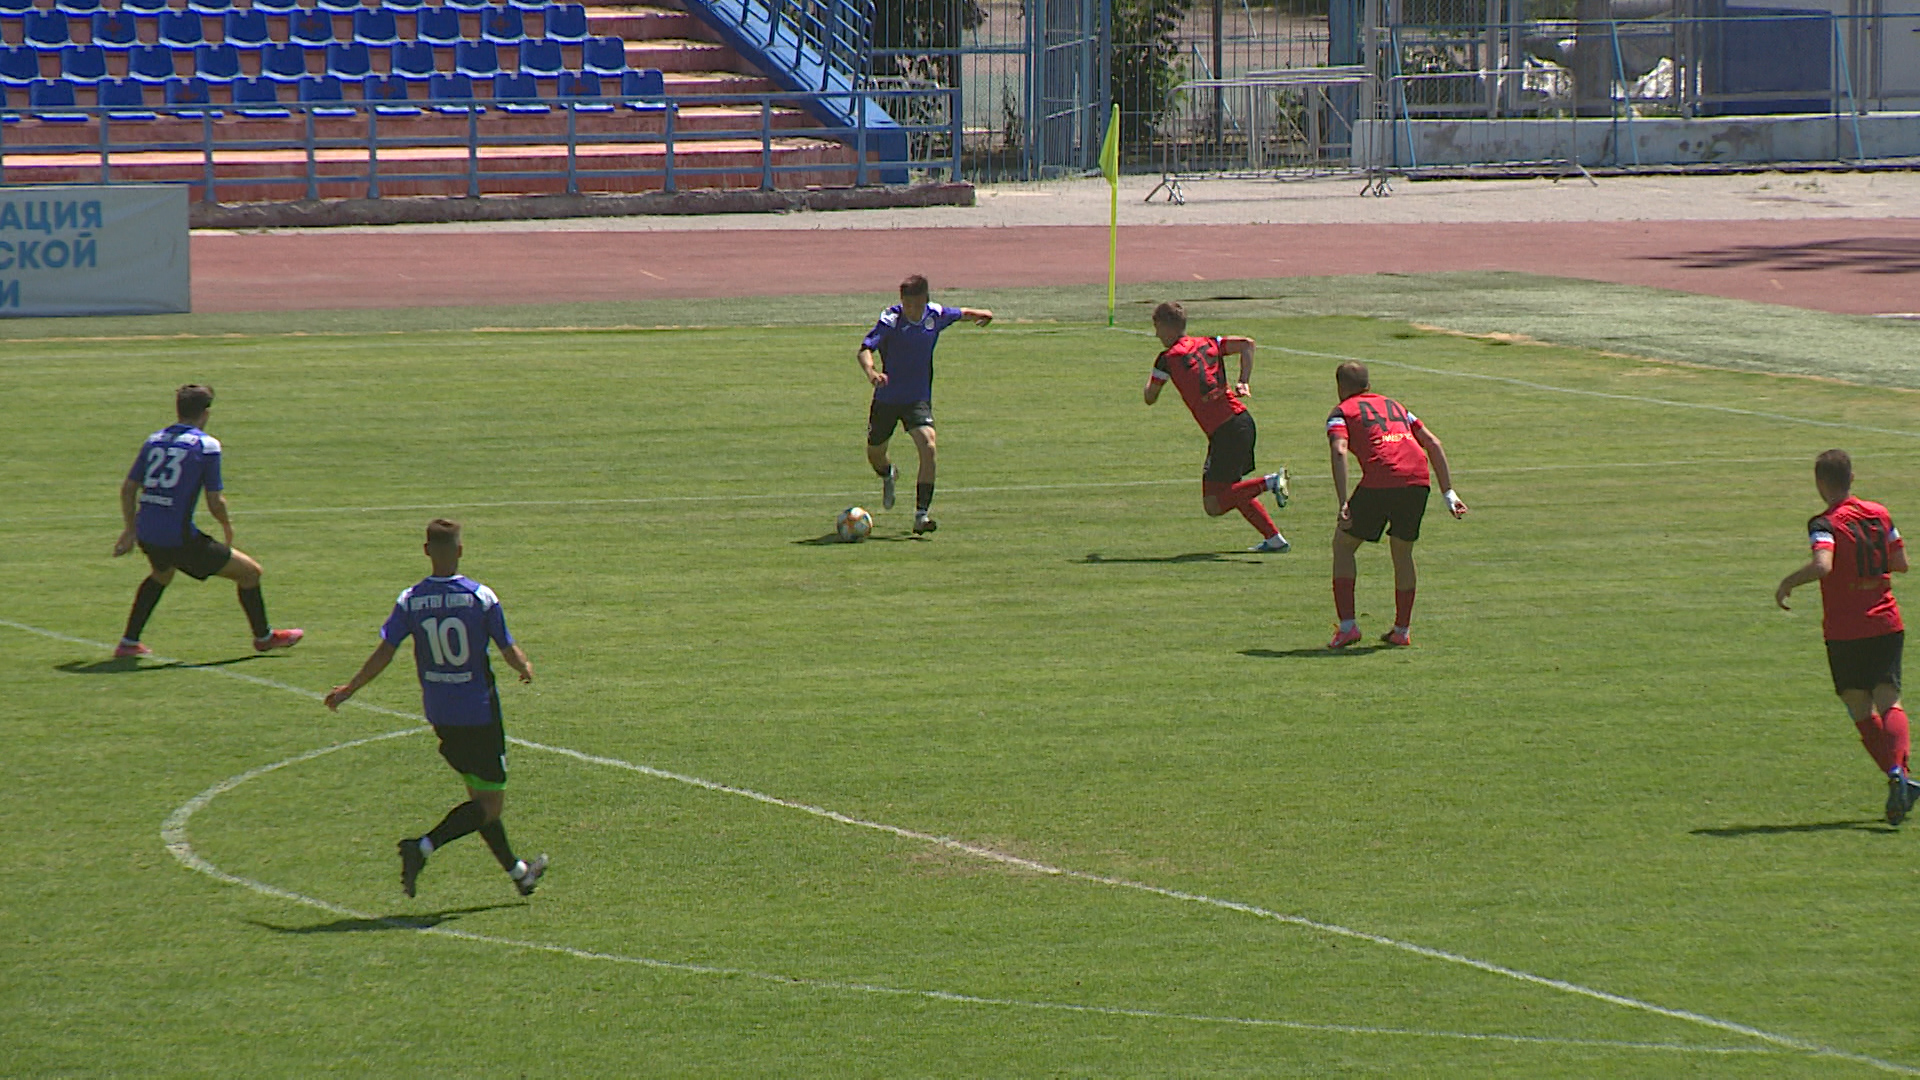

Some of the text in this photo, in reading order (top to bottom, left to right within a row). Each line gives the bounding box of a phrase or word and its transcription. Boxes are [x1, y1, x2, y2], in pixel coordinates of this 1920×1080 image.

[0, 201, 103, 235] АЦИЯ
[1358, 399, 1411, 433] 44
[144, 447, 188, 488] 23
[421, 617, 469, 666] 10
